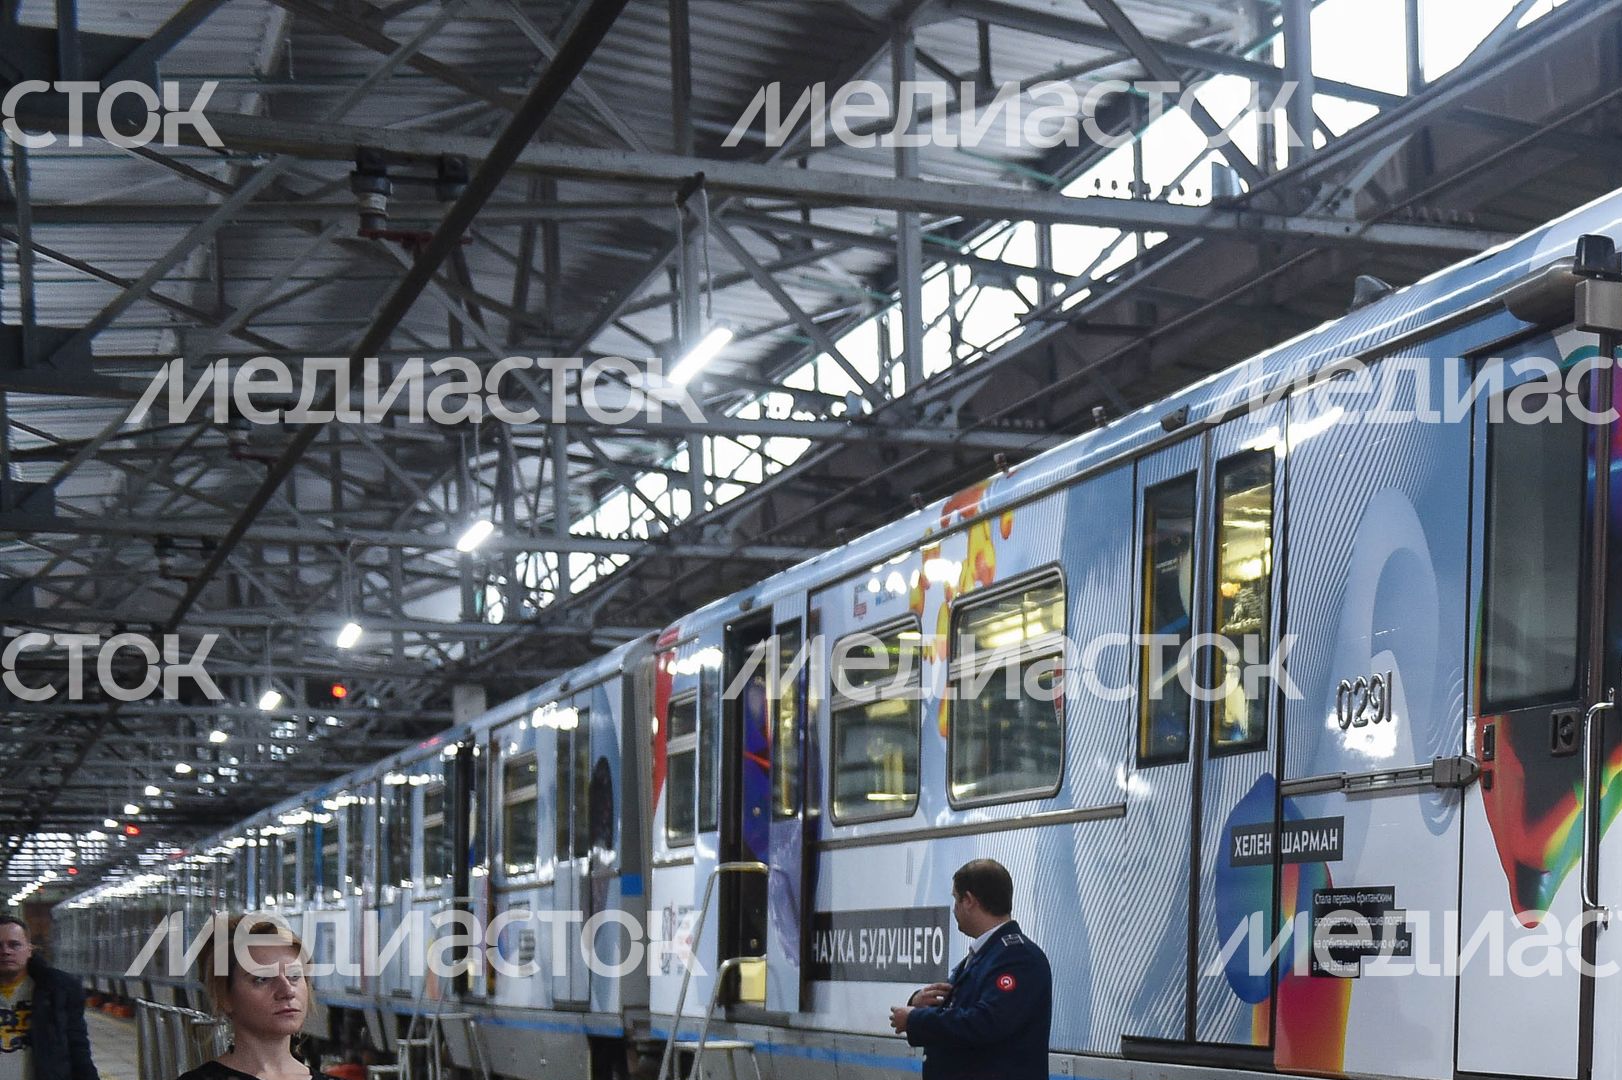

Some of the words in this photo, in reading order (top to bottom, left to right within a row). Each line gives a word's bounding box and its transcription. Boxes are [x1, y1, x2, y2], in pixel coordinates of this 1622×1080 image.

[1336, 669, 1392, 730] 0291
[1233, 832, 1272, 857] ХЕЛЕН
[1281, 828, 1339, 854] ШАРМАН
[813, 928, 855, 963] НАУКА
[860, 926, 943, 971] БУДУЩЕГО
